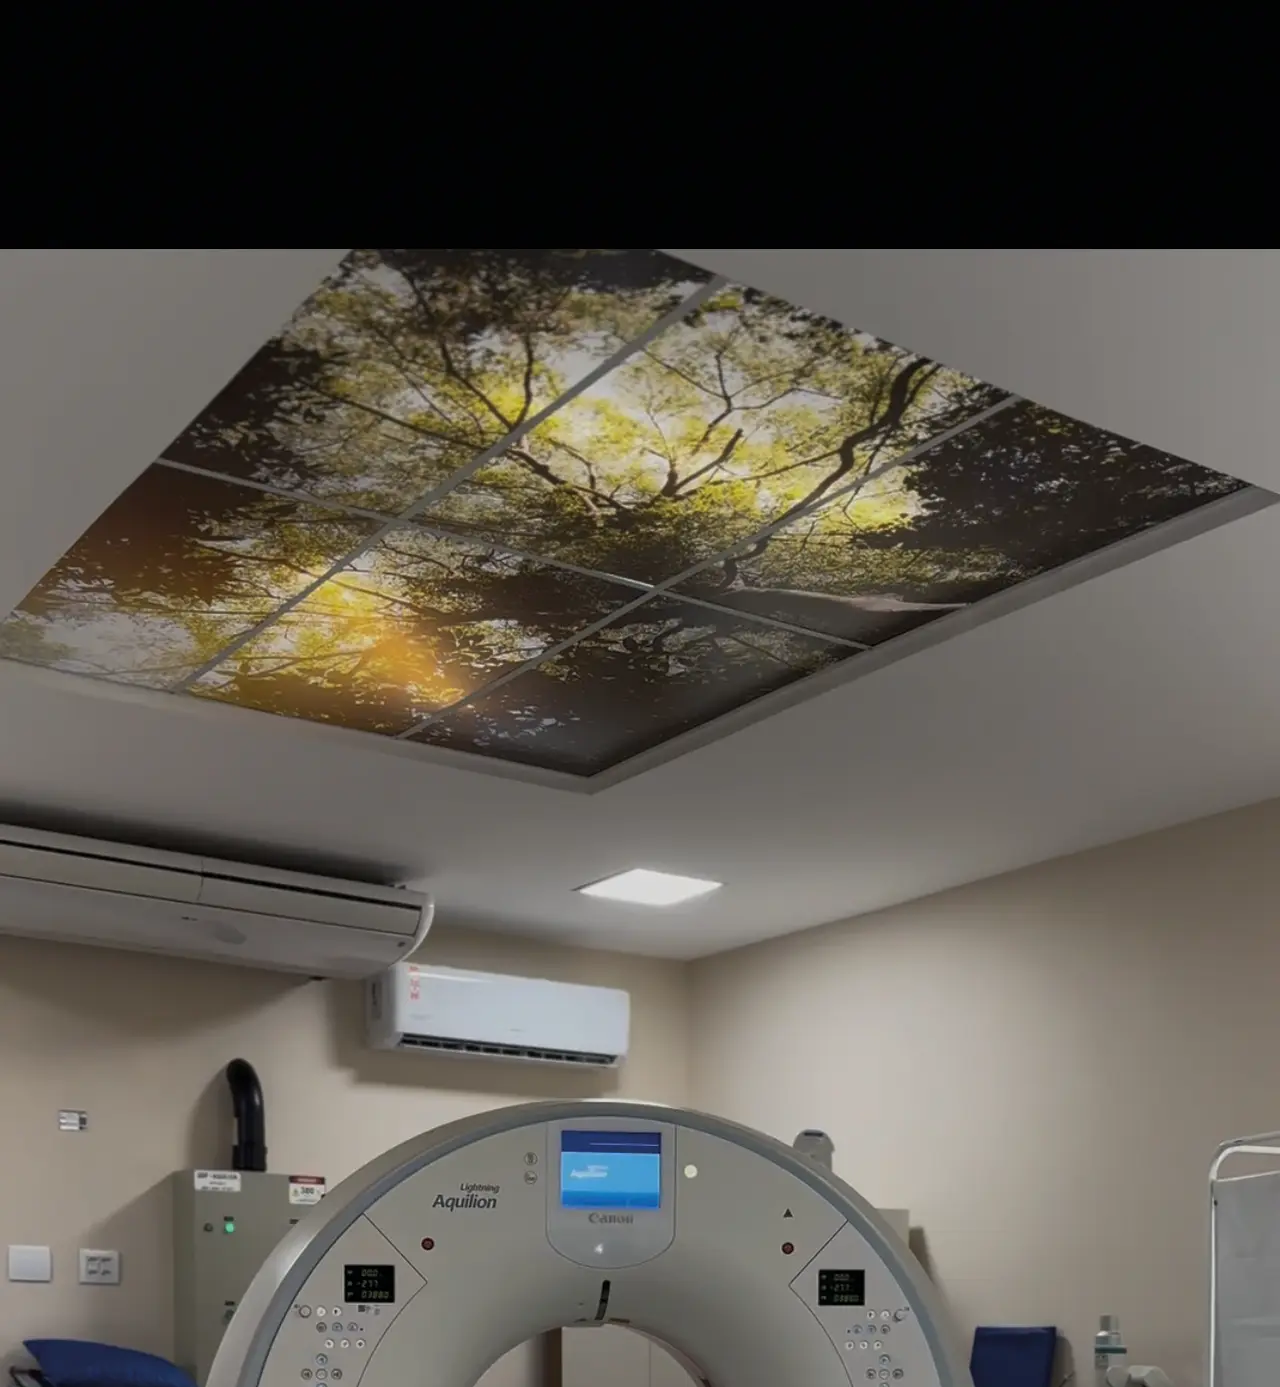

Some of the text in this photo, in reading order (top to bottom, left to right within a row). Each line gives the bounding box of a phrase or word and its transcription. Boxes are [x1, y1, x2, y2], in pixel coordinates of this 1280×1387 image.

[460, 1183, 500, 1194] Lightning
[432, 1194, 497, 1212] Aquilion
[588, 1212, 634, 1224] Canon
